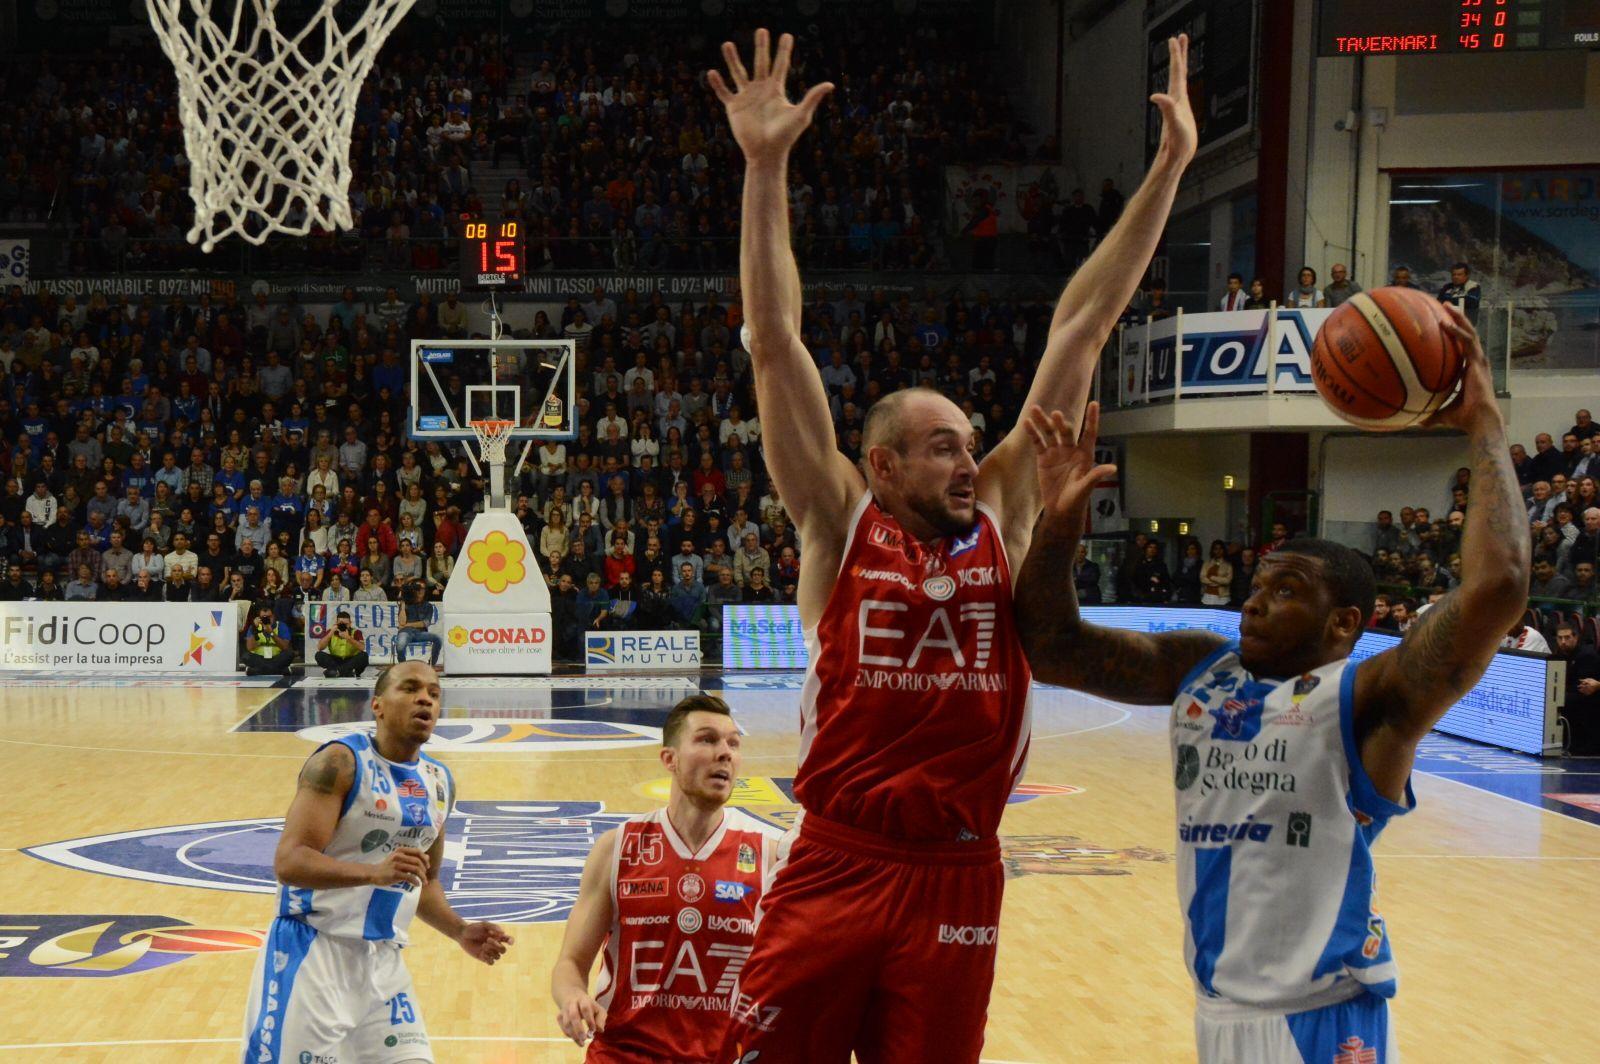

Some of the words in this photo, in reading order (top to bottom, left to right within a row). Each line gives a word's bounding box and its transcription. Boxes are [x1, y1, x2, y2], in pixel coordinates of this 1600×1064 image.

[1460, 13, 1481, 27] 34
[1494, 12, 1506, 27] 0
[1336, 35, 1441, 52] TAVERNARI
[1459, 34, 1480, 48] 45
[1493, 34, 1505, 48] 0
[466, 223, 486, 239] 08
[501, 222, 517, 238] 10
[482, 241, 516, 272] 15
[44, 280, 83, 296] TASSO
[555, 278, 595, 294] TASSO
[4, 615, 166, 653] FidiCoop
[469, 628, 546, 644] CONAD
[621, 636, 698, 651] REALE
[858, 599, 996, 669] EA7
[4, 653, 50, 664] L'assist
[53, 655, 74, 668] per
[77, 653, 88, 664] la
[91, 655, 111, 664] tua
[114, 653, 164, 668] impresa
[621, 654, 699, 664] MUTUA
[855, 669, 931, 690] EMPORIO
[955, 672, 1007, 692] ARMANI
[1264, 739, 1287, 762] di
[368, 759, 391, 795] 25
[620, 833, 664, 866] 45
[622, 881, 664, 896] UMANA
[715, 884, 744, 900] SAP
[630, 940, 753, 993] EA7
[385, 992, 416, 1026] 25
[631, 993, 681, 1010] EMPORIO
[733, 992, 783, 1027] EA7
